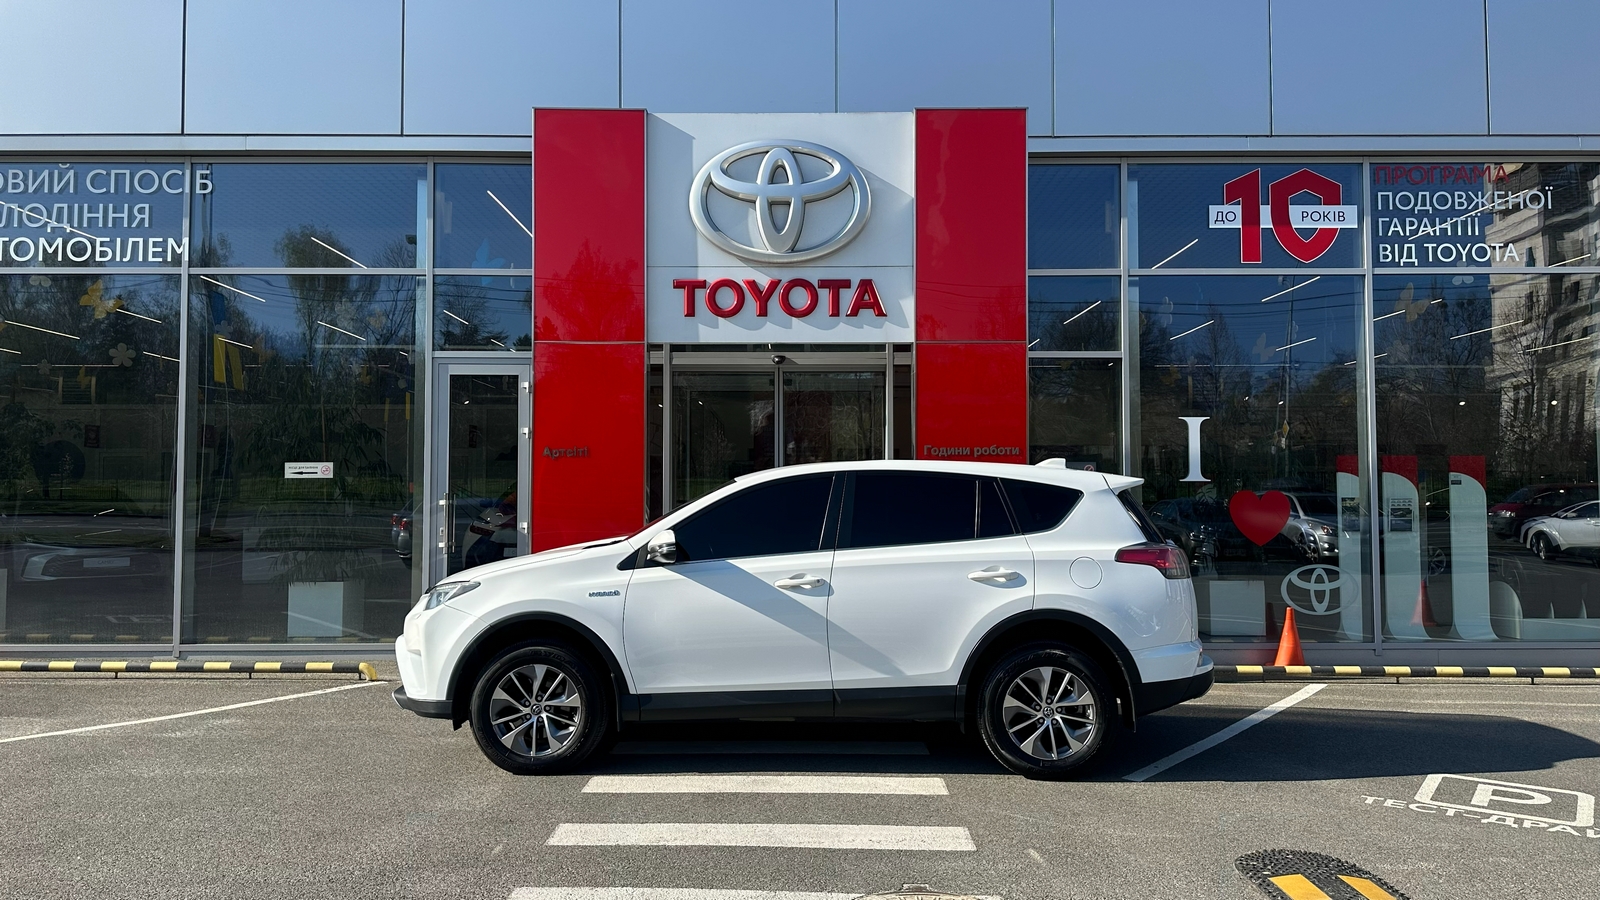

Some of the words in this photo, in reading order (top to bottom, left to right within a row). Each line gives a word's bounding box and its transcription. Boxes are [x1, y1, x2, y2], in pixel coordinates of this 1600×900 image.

[0, 163, 75, 194] ВИЙ
[86, 169, 213, 194] СПОСІБ
[1375, 165, 1510, 185] ПРОГРАМА
[1377, 186, 1554, 214] ПОДОВЖЕНОЇ
[1214, 211, 1237, 225] ДО
[1224, 168, 1342, 264] 10
[1301, 211, 1346, 222] РОКІВ
[1378, 213, 1482, 237] ГАРАНТІЇ
[1379, 243, 1418, 267] ВІД
[1423, 243, 1520, 263] TOYOTA
[672, 278, 888, 318] TOYOTA
[923, 445, 971, 457] Години
[973, 445, 1020, 458] роботи
[1470, 783, 1552, 807] P
